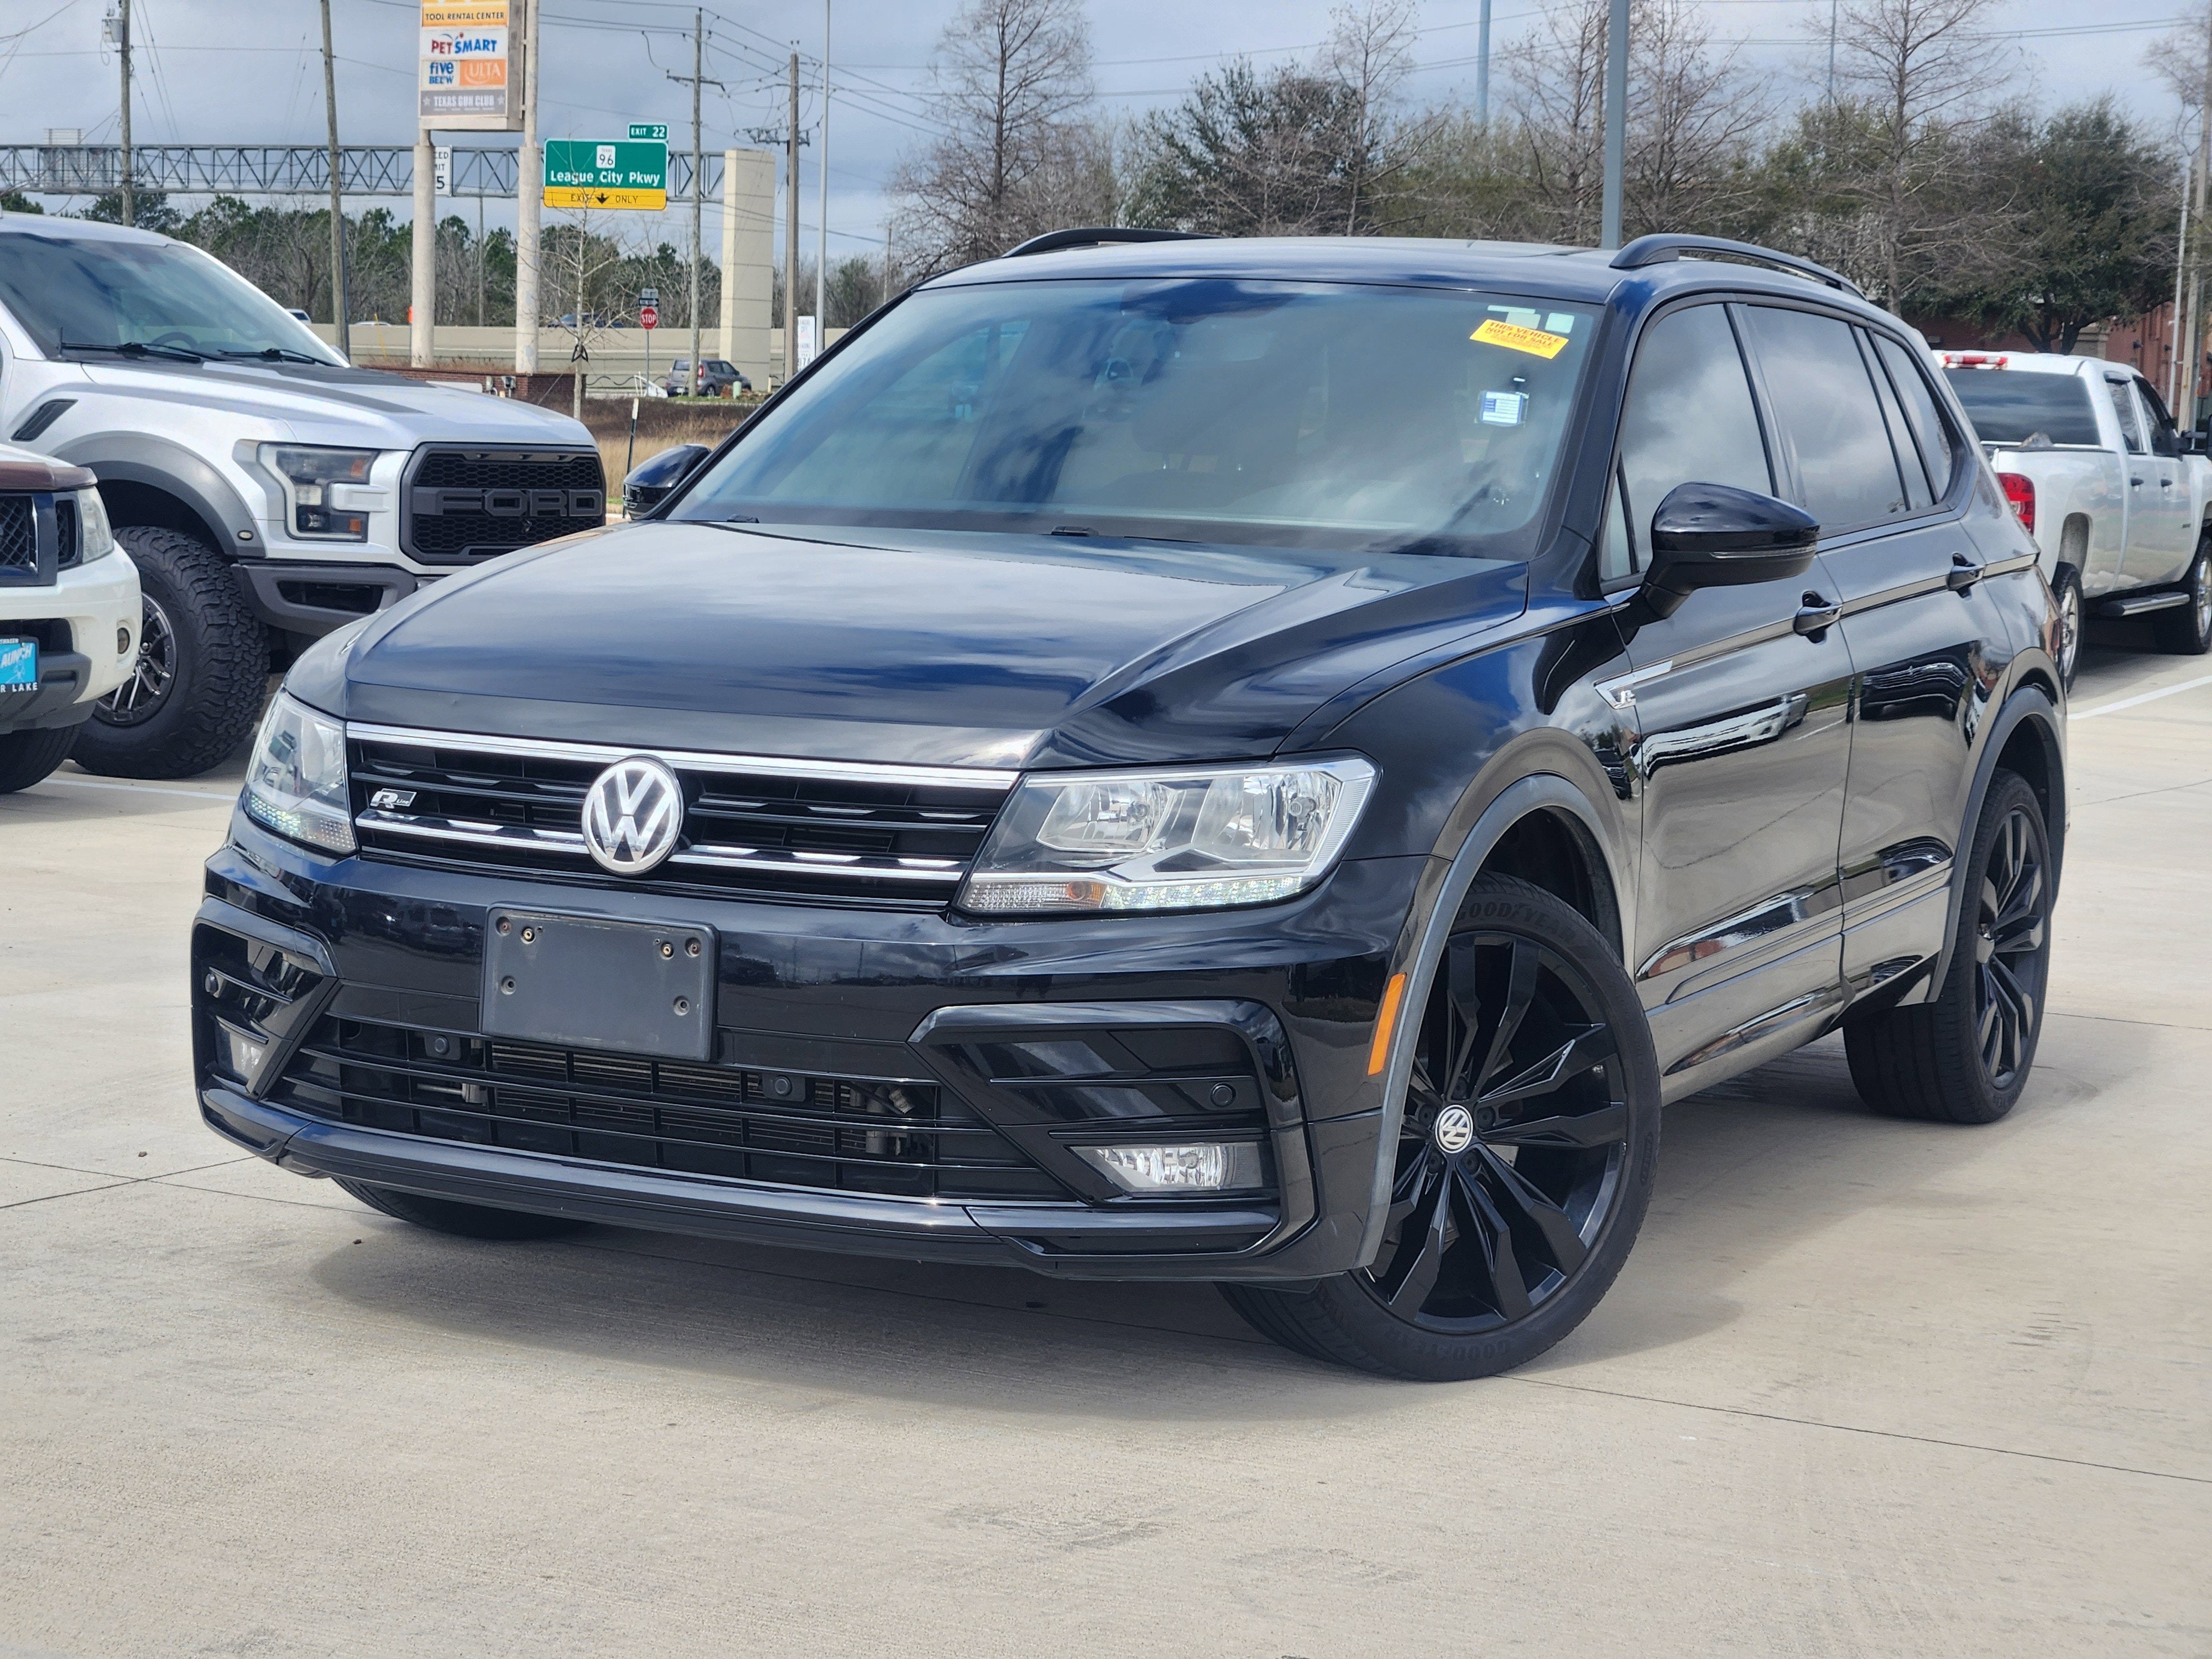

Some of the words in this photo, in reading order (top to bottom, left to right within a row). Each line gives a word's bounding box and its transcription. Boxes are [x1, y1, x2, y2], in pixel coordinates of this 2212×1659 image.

[469, 62, 502, 77] ULTA
[433, 95, 457, 107] TEXAS
[458, 95, 473, 107] GUN
[474, 95, 494, 107] CLUB
[631, 127, 646, 136] EXIT
[652, 127, 665, 138] 22
[599, 154, 614, 165] 96
[550, 170, 593, 185] League
[599, 171, 623, 186] City
[629, 171, 660, 186] Pkwy
[615, 195, 639, 204] ONLY
[641, 314, 656, 324] STOP
[1489, 322, 1512, 331] THIS
[1517, 327, 1561, 343] VEHICLE
[1507, 331, 1527, 340] FOR
[1530, 336, 1554, 347] SALE
[435, 488, 603, 517] FORD
[0, 643, 33, 668] AUNCH
[12, 682, 38, 692] LAKE
[370, 791, 398, 808] R
